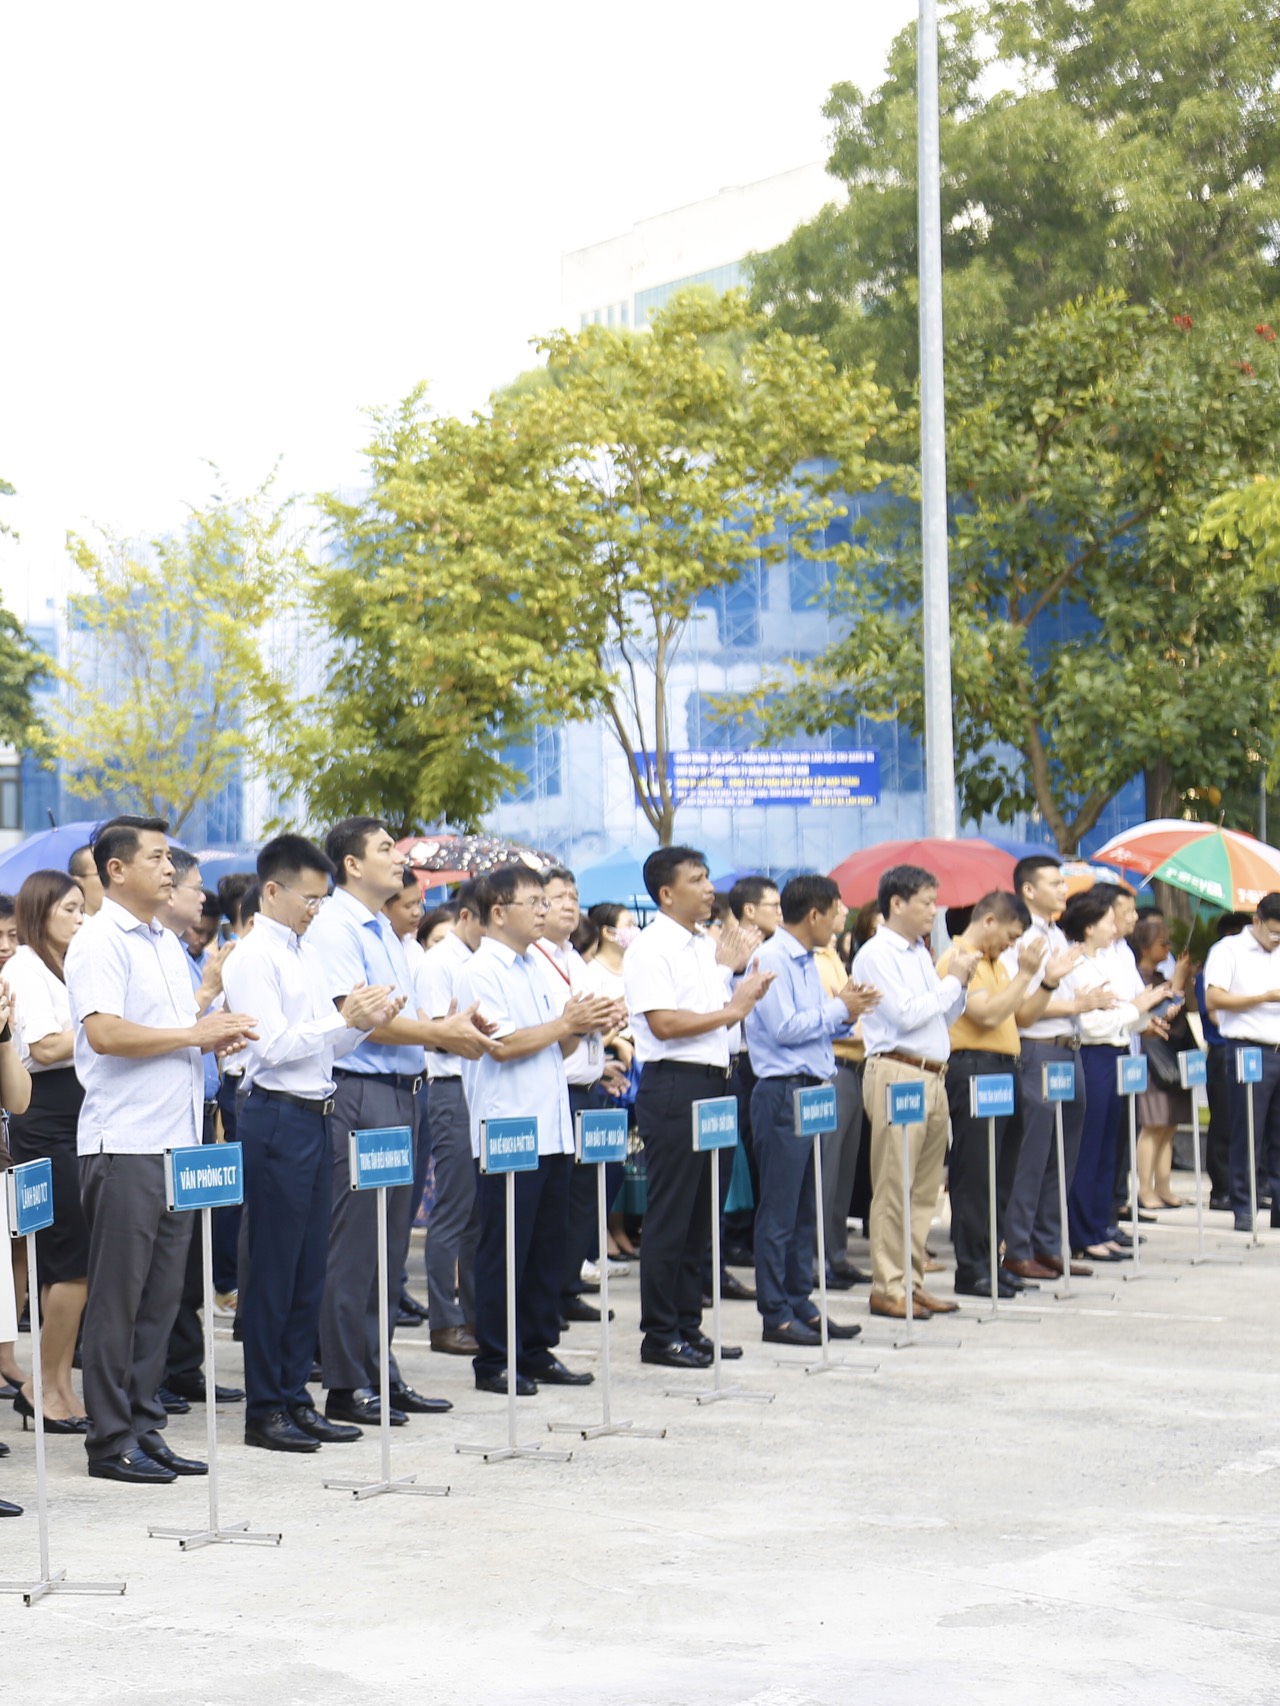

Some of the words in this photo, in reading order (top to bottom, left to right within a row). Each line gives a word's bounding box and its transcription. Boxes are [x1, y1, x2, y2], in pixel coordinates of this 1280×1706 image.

[585, 1131, 593, 1148] BAN
[180, 1166, 196, 1190] VĂN
[197, 1164, 223, 1189] PHÒNG
[223, 1166, 237, 1186] TCT
